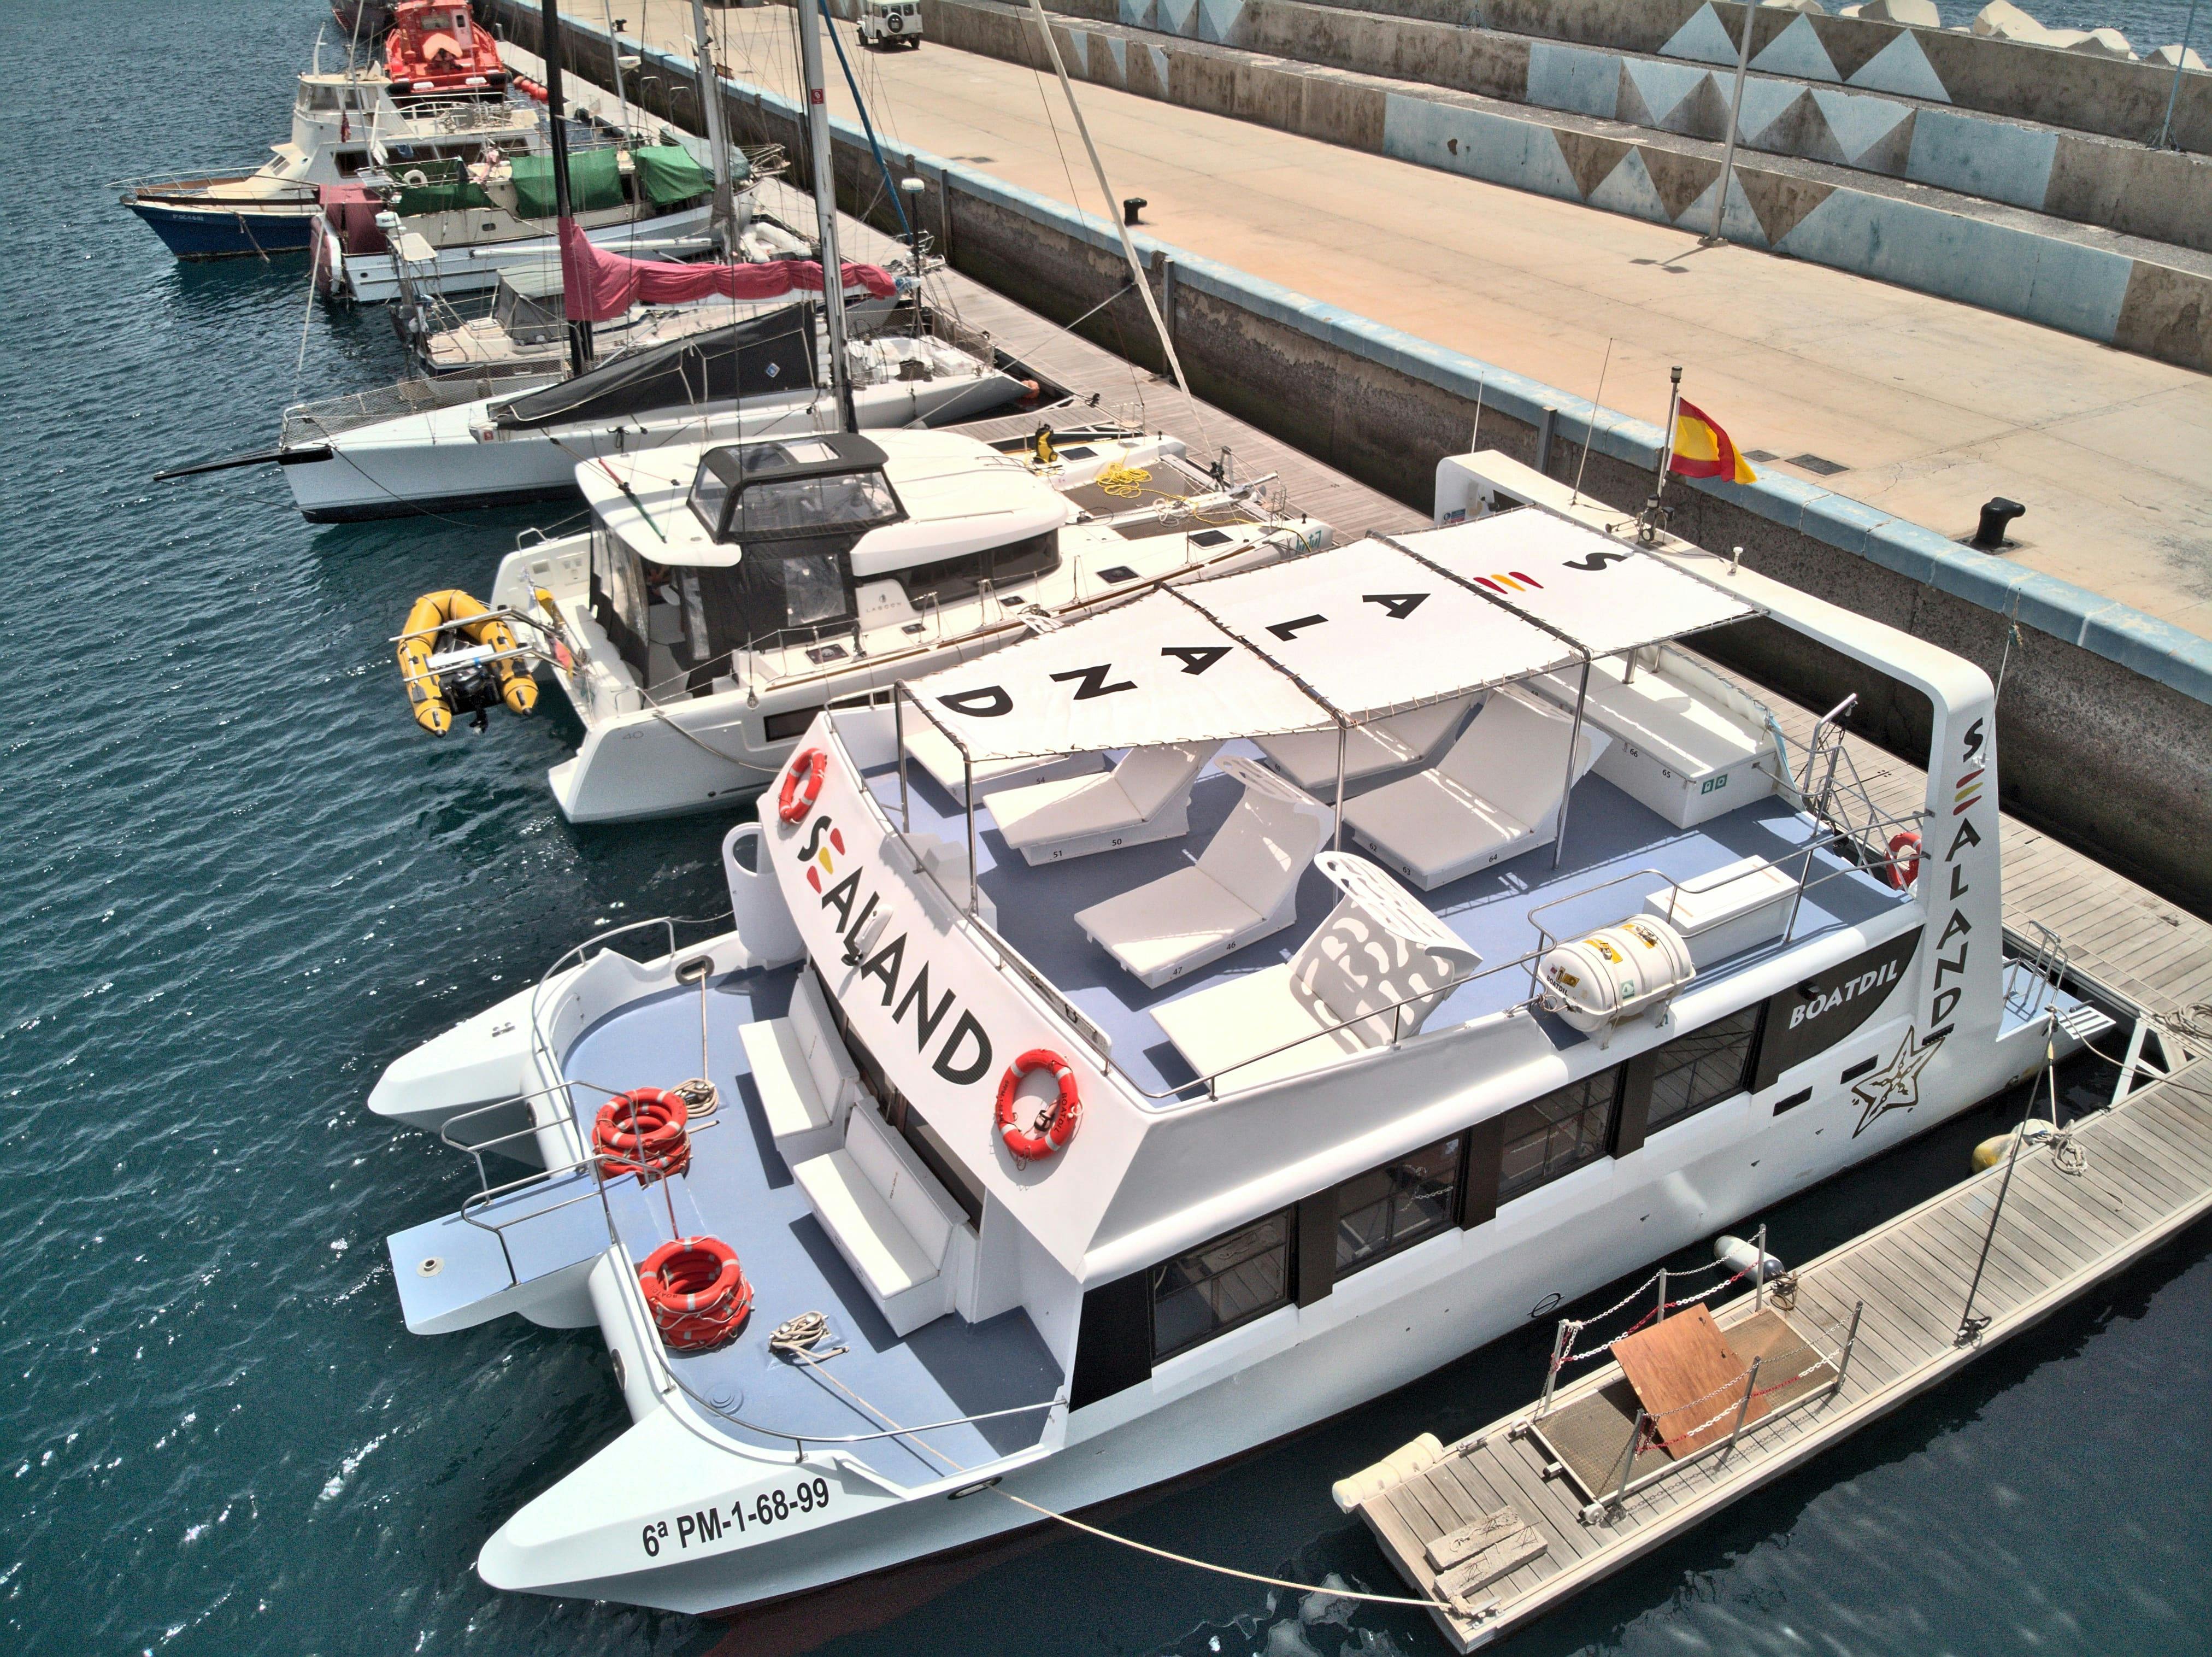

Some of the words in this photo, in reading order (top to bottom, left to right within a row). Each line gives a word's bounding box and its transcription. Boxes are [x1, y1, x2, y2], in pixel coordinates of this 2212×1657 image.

[622, 731, 644, 739] 40
[1629, 748, 1638, 757] 66
[1662, 769, 1671, 778] 65
[1036, 777, 1045, 785] 54
[1111, 838, 1122, 847] 50
[1369, 843, 1378, 853] 62
[1489, 854, 1498, 863] 64
[1403, 866, 1411, 875] 63
[1931, 717, 1985, 1029] SEALAND
[1226, 941, 1236, 950] 46
[1173, 966, 1183, 976] 47
[1546, 975, 1568, 997] BOATDIL
[1789, 959, 1898, 1030] BOATDIL
[1054, 1092, 1068, 1133] BOATDIL
[642, 1521, 669, 1557] 6ª
[676, 1477, 829, 1549] PM-1-68-99
